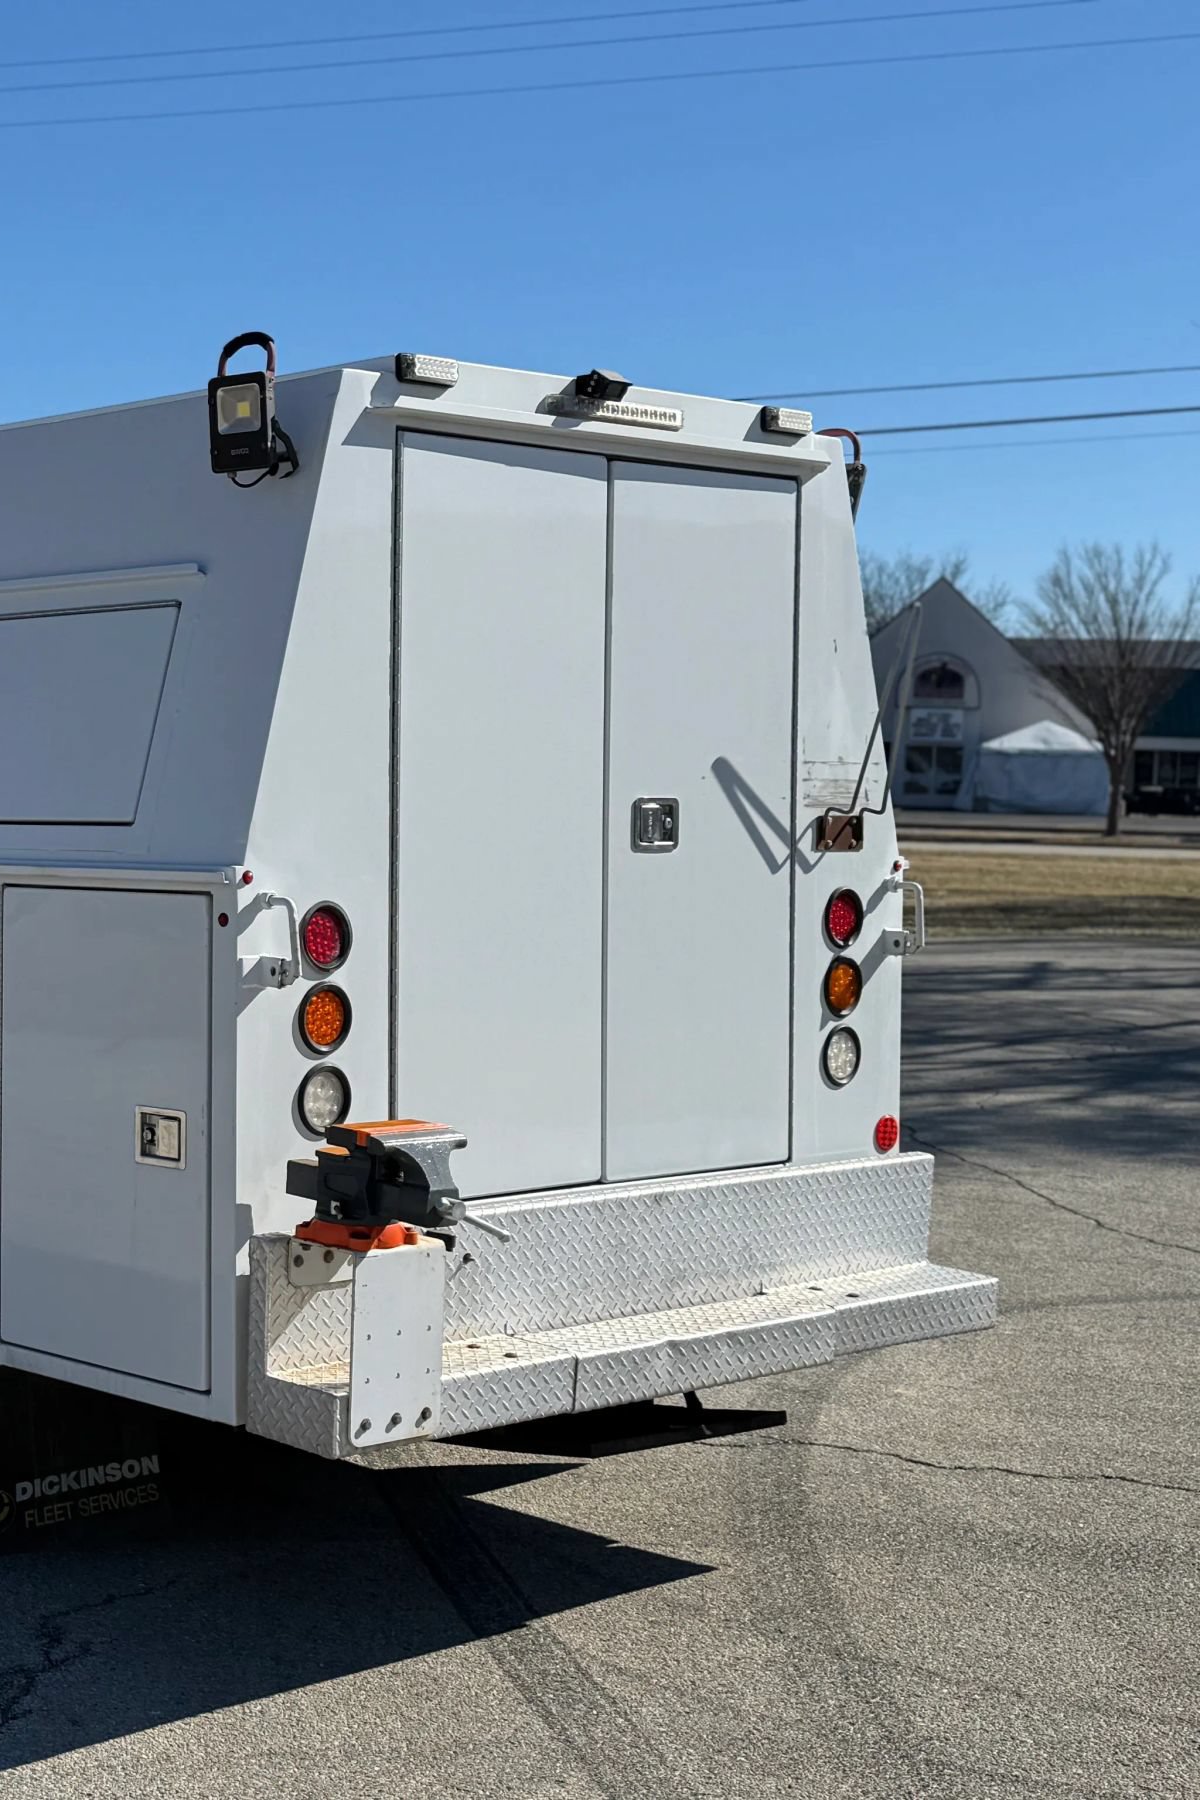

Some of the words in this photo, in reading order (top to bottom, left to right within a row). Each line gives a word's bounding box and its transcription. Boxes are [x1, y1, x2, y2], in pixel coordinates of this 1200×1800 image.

[16, 1454, 160, 1502] DICKINSON
[25, 1501, 74, 1528] FLEET
[79, 1483, 160, 1517] SERVICES
